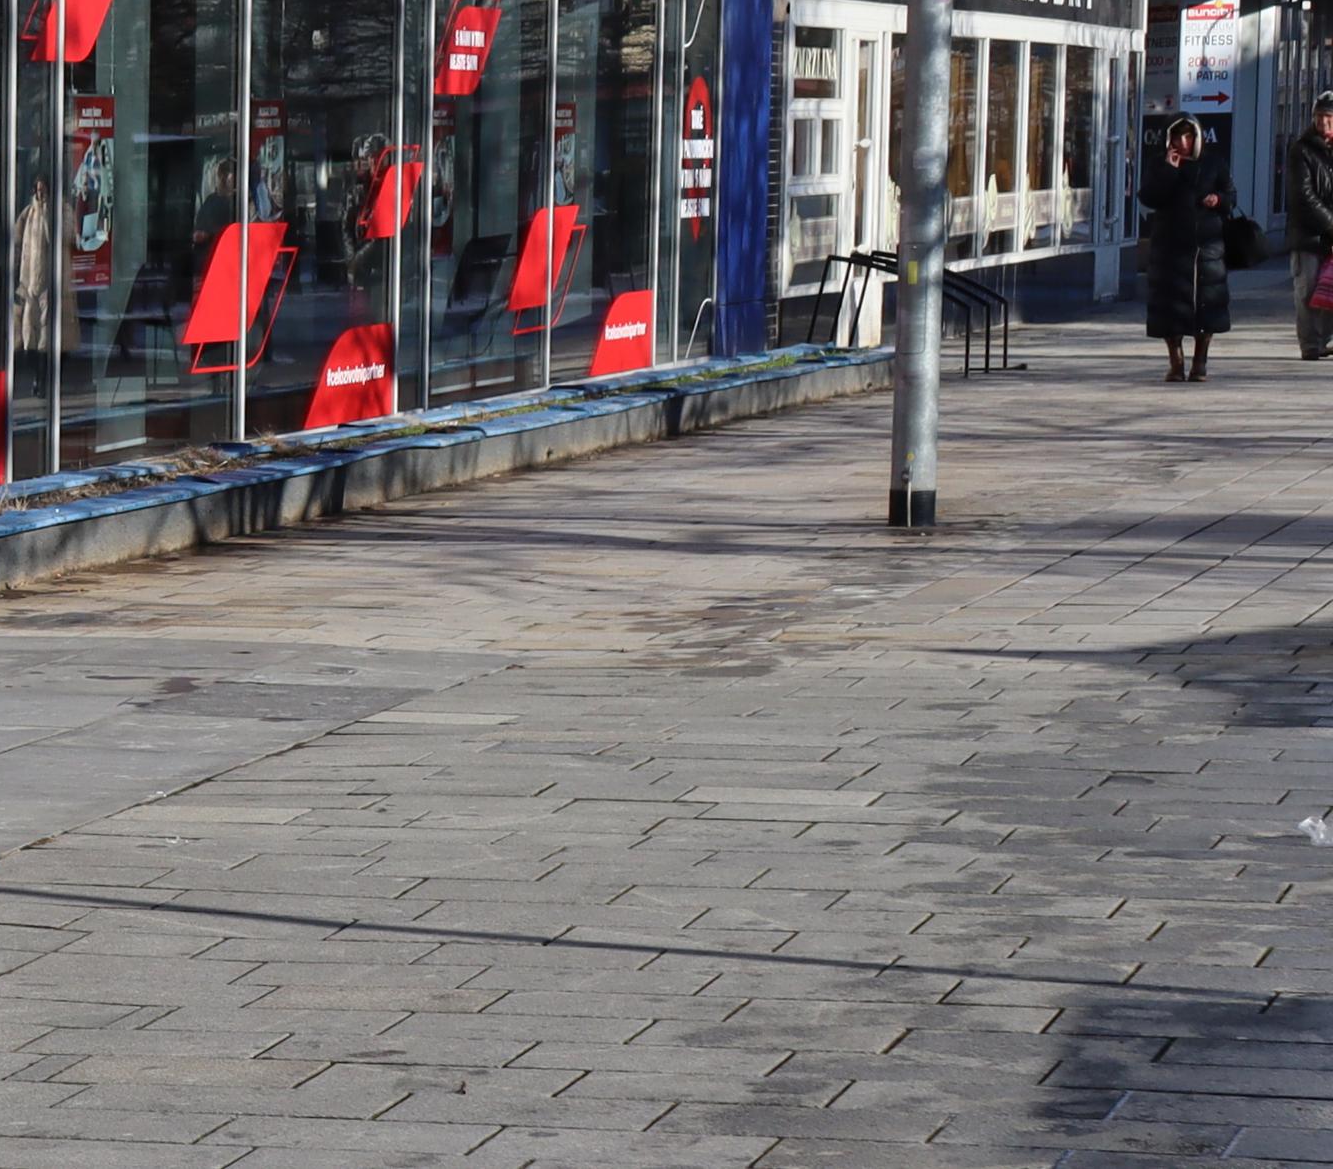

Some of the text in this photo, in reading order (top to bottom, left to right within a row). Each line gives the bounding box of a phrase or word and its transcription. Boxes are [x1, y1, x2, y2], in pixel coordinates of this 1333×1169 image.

[1188, 8, 1232, 20] suncity
[1185, 35, 1233, 46] FITNESS
[1188, 57, 1215, 68] 2000
[1197, 70, 1228, 81] PATRO
